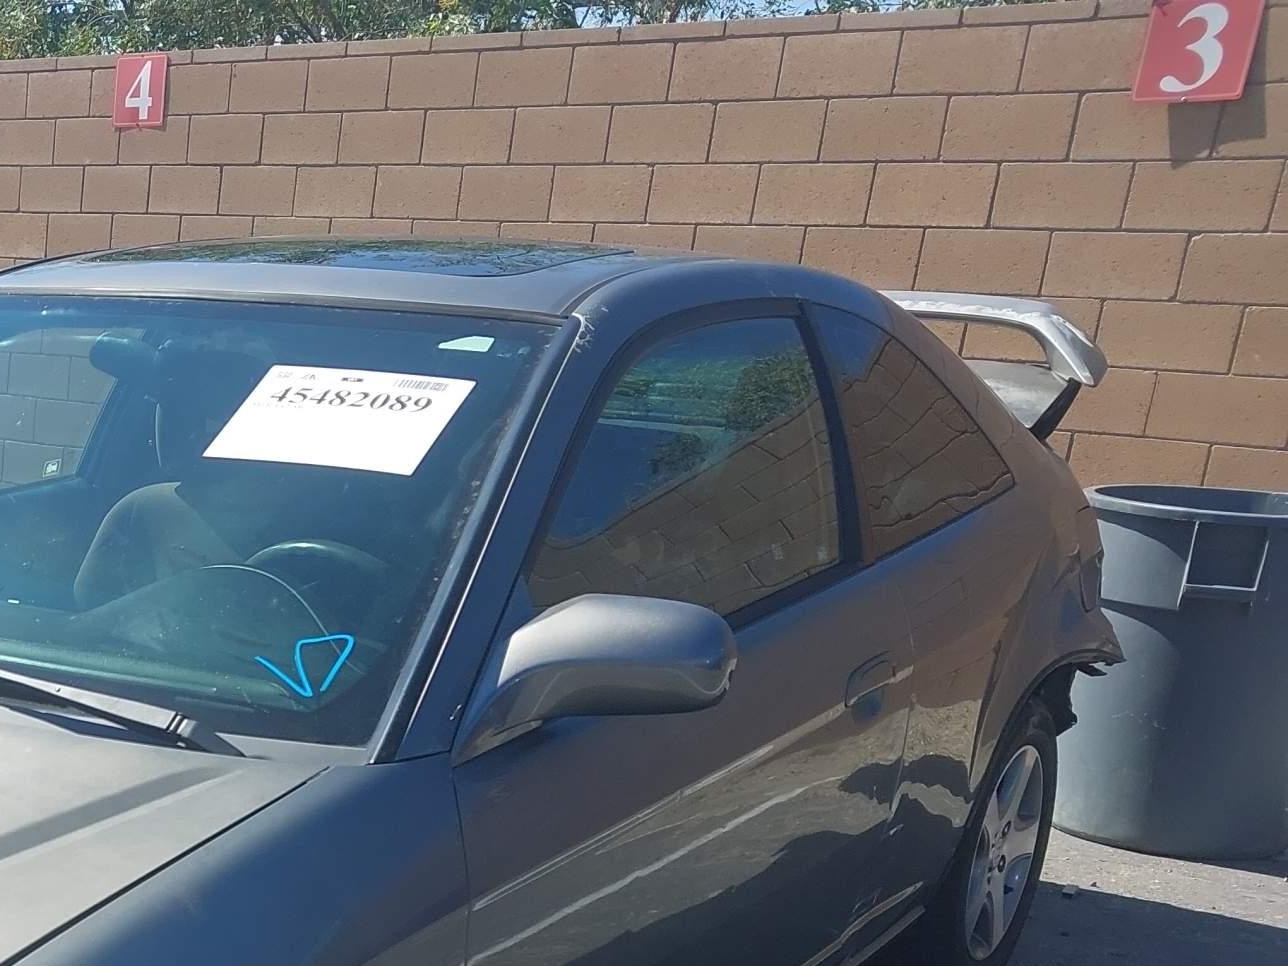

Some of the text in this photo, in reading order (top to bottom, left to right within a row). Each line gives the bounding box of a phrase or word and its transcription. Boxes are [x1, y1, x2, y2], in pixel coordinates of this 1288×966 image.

[1159, 2, 1230, 93] 3
[124, 59, 153, 120] 4
[269, 386, 433, 413] 45482089
